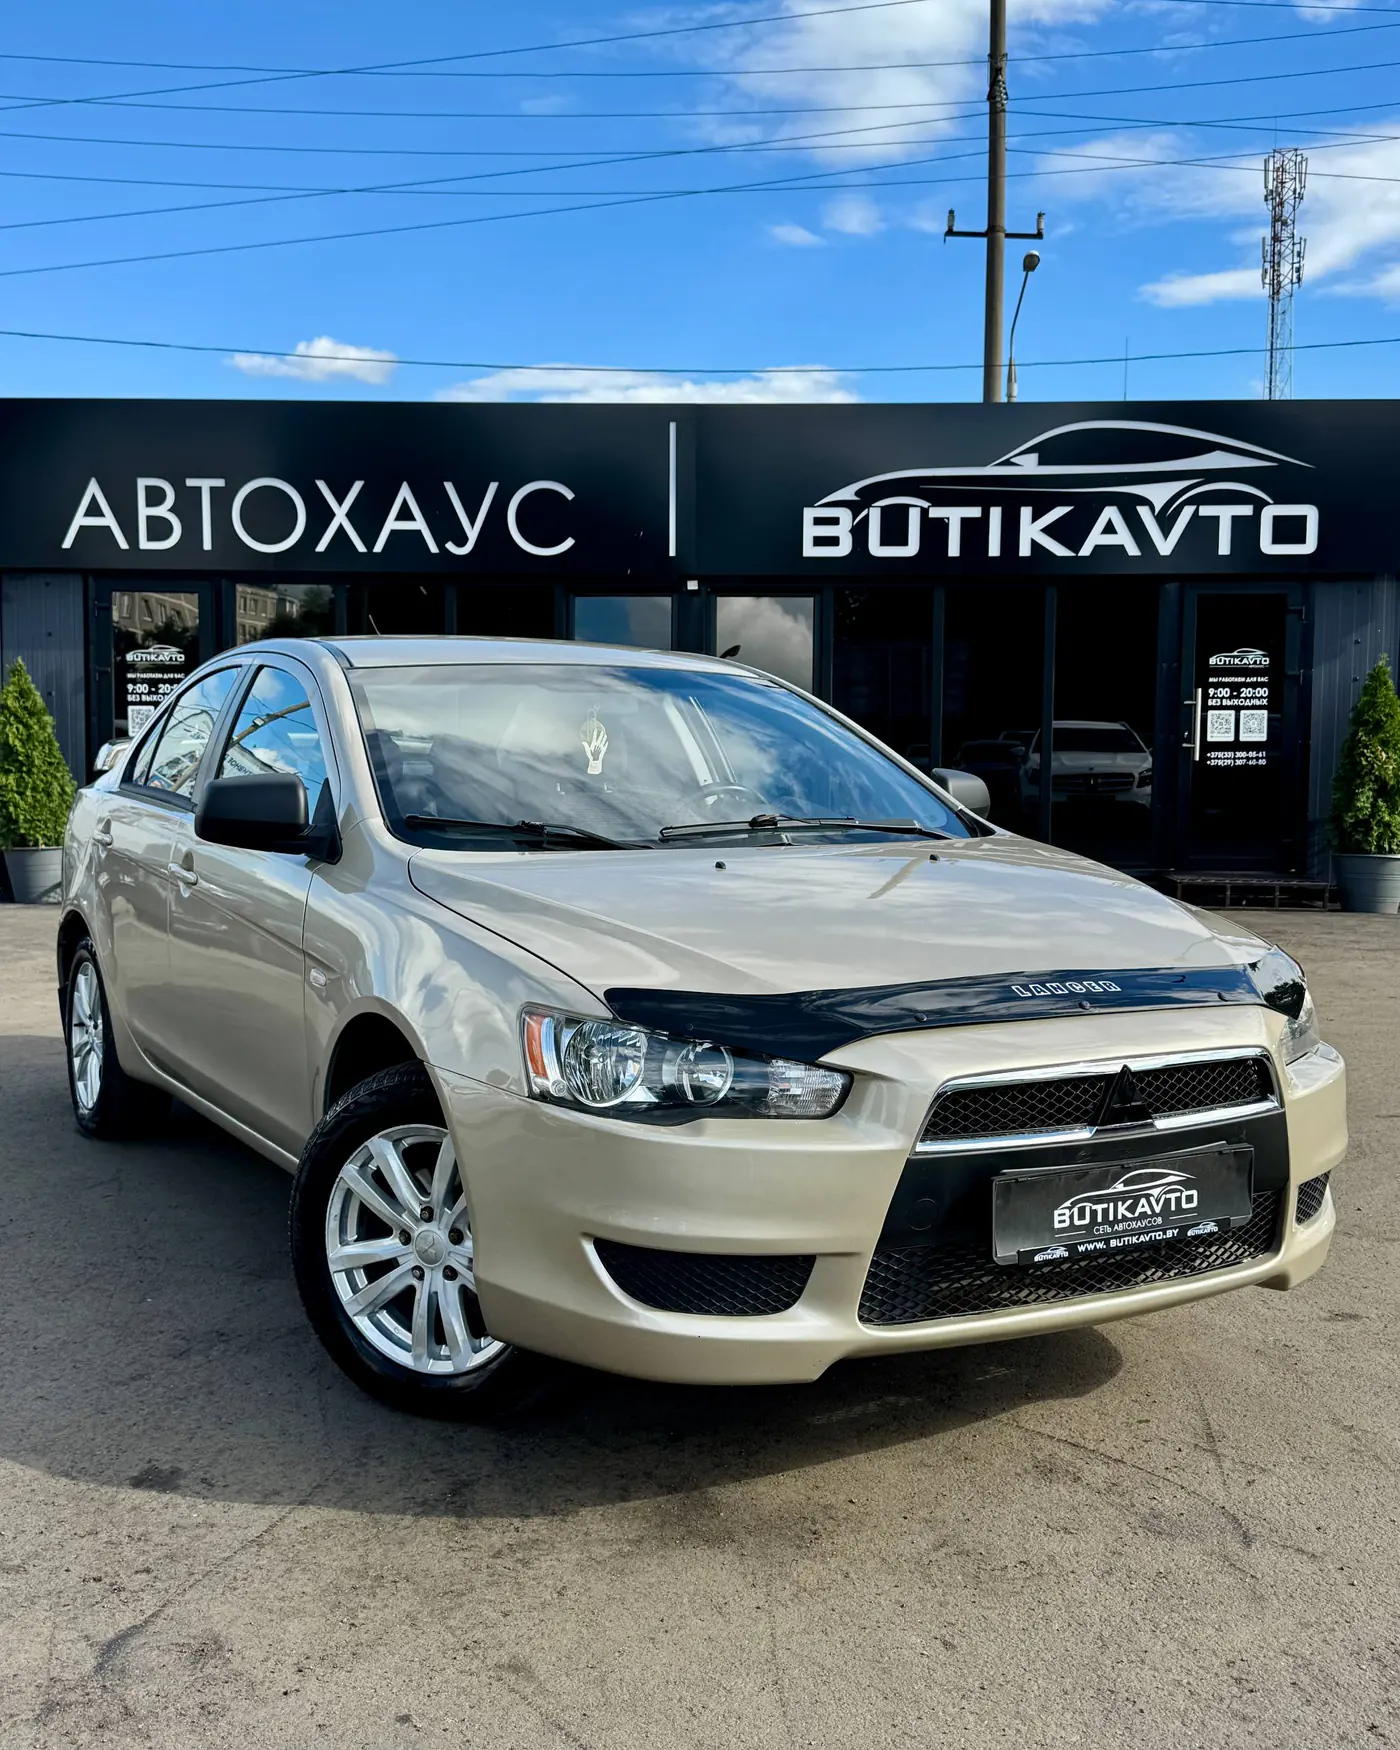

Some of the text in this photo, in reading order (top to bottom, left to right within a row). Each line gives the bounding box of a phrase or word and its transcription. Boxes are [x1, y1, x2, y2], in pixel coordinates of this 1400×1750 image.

[61, 476, 576, 556] АВТОХАУС
[802, 503, 1319, 558] BUTIKAVTO
[126, 653, 185, 661] BUTIKAVTO
[1209, 657, 1270, 665] BUTIKAVTO
[127, 683, 149, 693] 9:00
[158, 683, 179, 693] 20:
[1208, 688, 1230, 697] 9:00
[1240, 687, 1268, 697] 20:00
[1222, 698, 1268, 706] ВЫХОДНЫХ
[1207, 751, 1234, 759] +375(33)
[1207, 759, 1234, 767] +375(29)
[1011, 980, 1122, 997] LANCER
[1053, 1189, 1198, 1229] BUTIKAVTO
[1093, 1216, 1163, 1235] СЕТЬ АВТОХАУСОВ
[1187, 1226, 1219, 1237] BUTIKAVTO
[1077, 1229, 1179, 1252] WWW. BUTIKAVTO.BY
[1034, 1251, 1069, 1262] BUTIKAVTO
